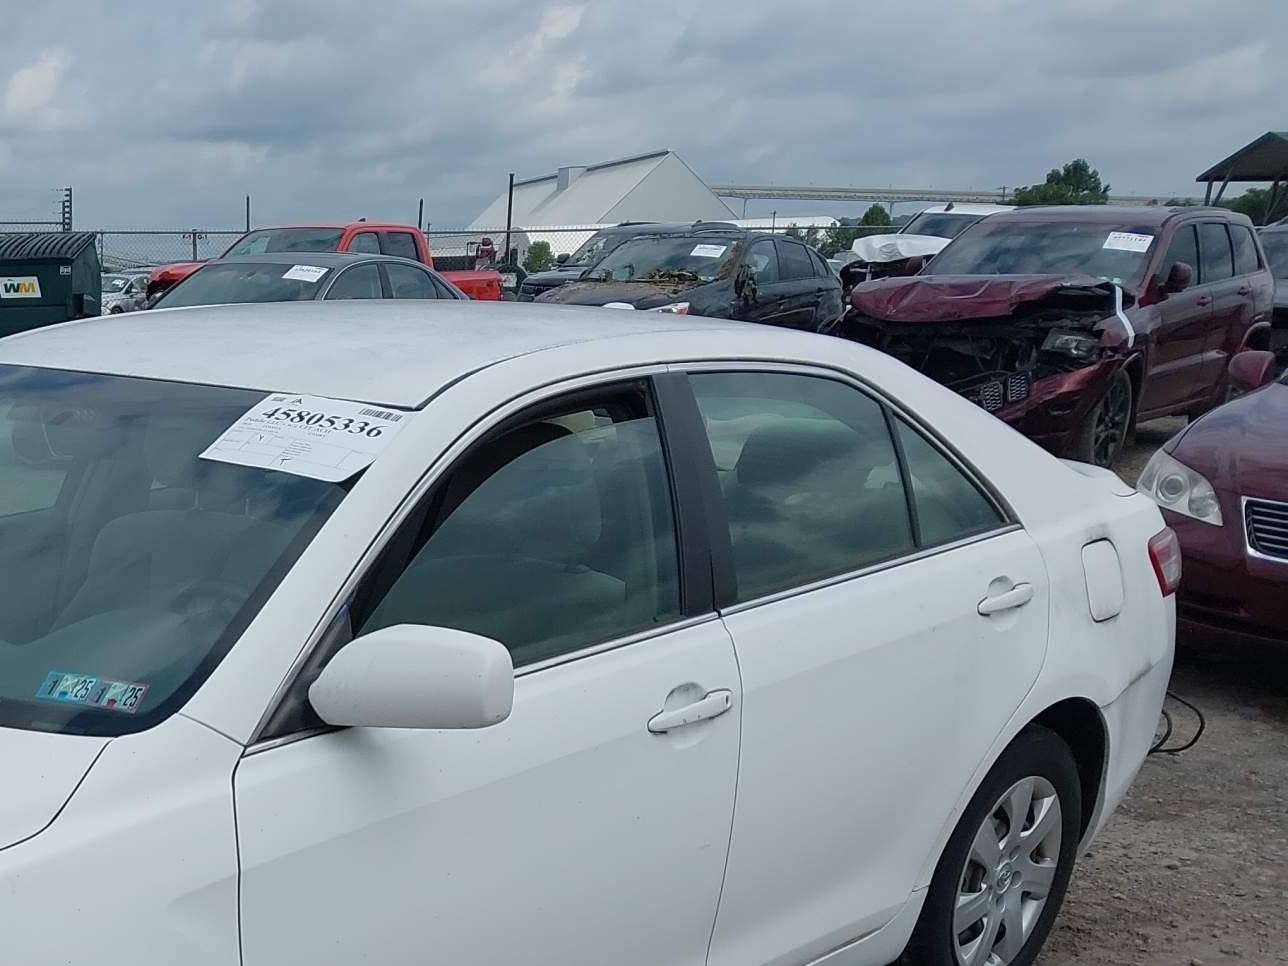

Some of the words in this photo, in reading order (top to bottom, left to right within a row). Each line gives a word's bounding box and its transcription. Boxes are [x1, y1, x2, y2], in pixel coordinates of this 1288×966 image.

[3, 282, 36, 294] WM
[261, 407, 389, 439] 45805336
[73, 679, 94, 699] 25
[122, 687, 143, 707] 25
